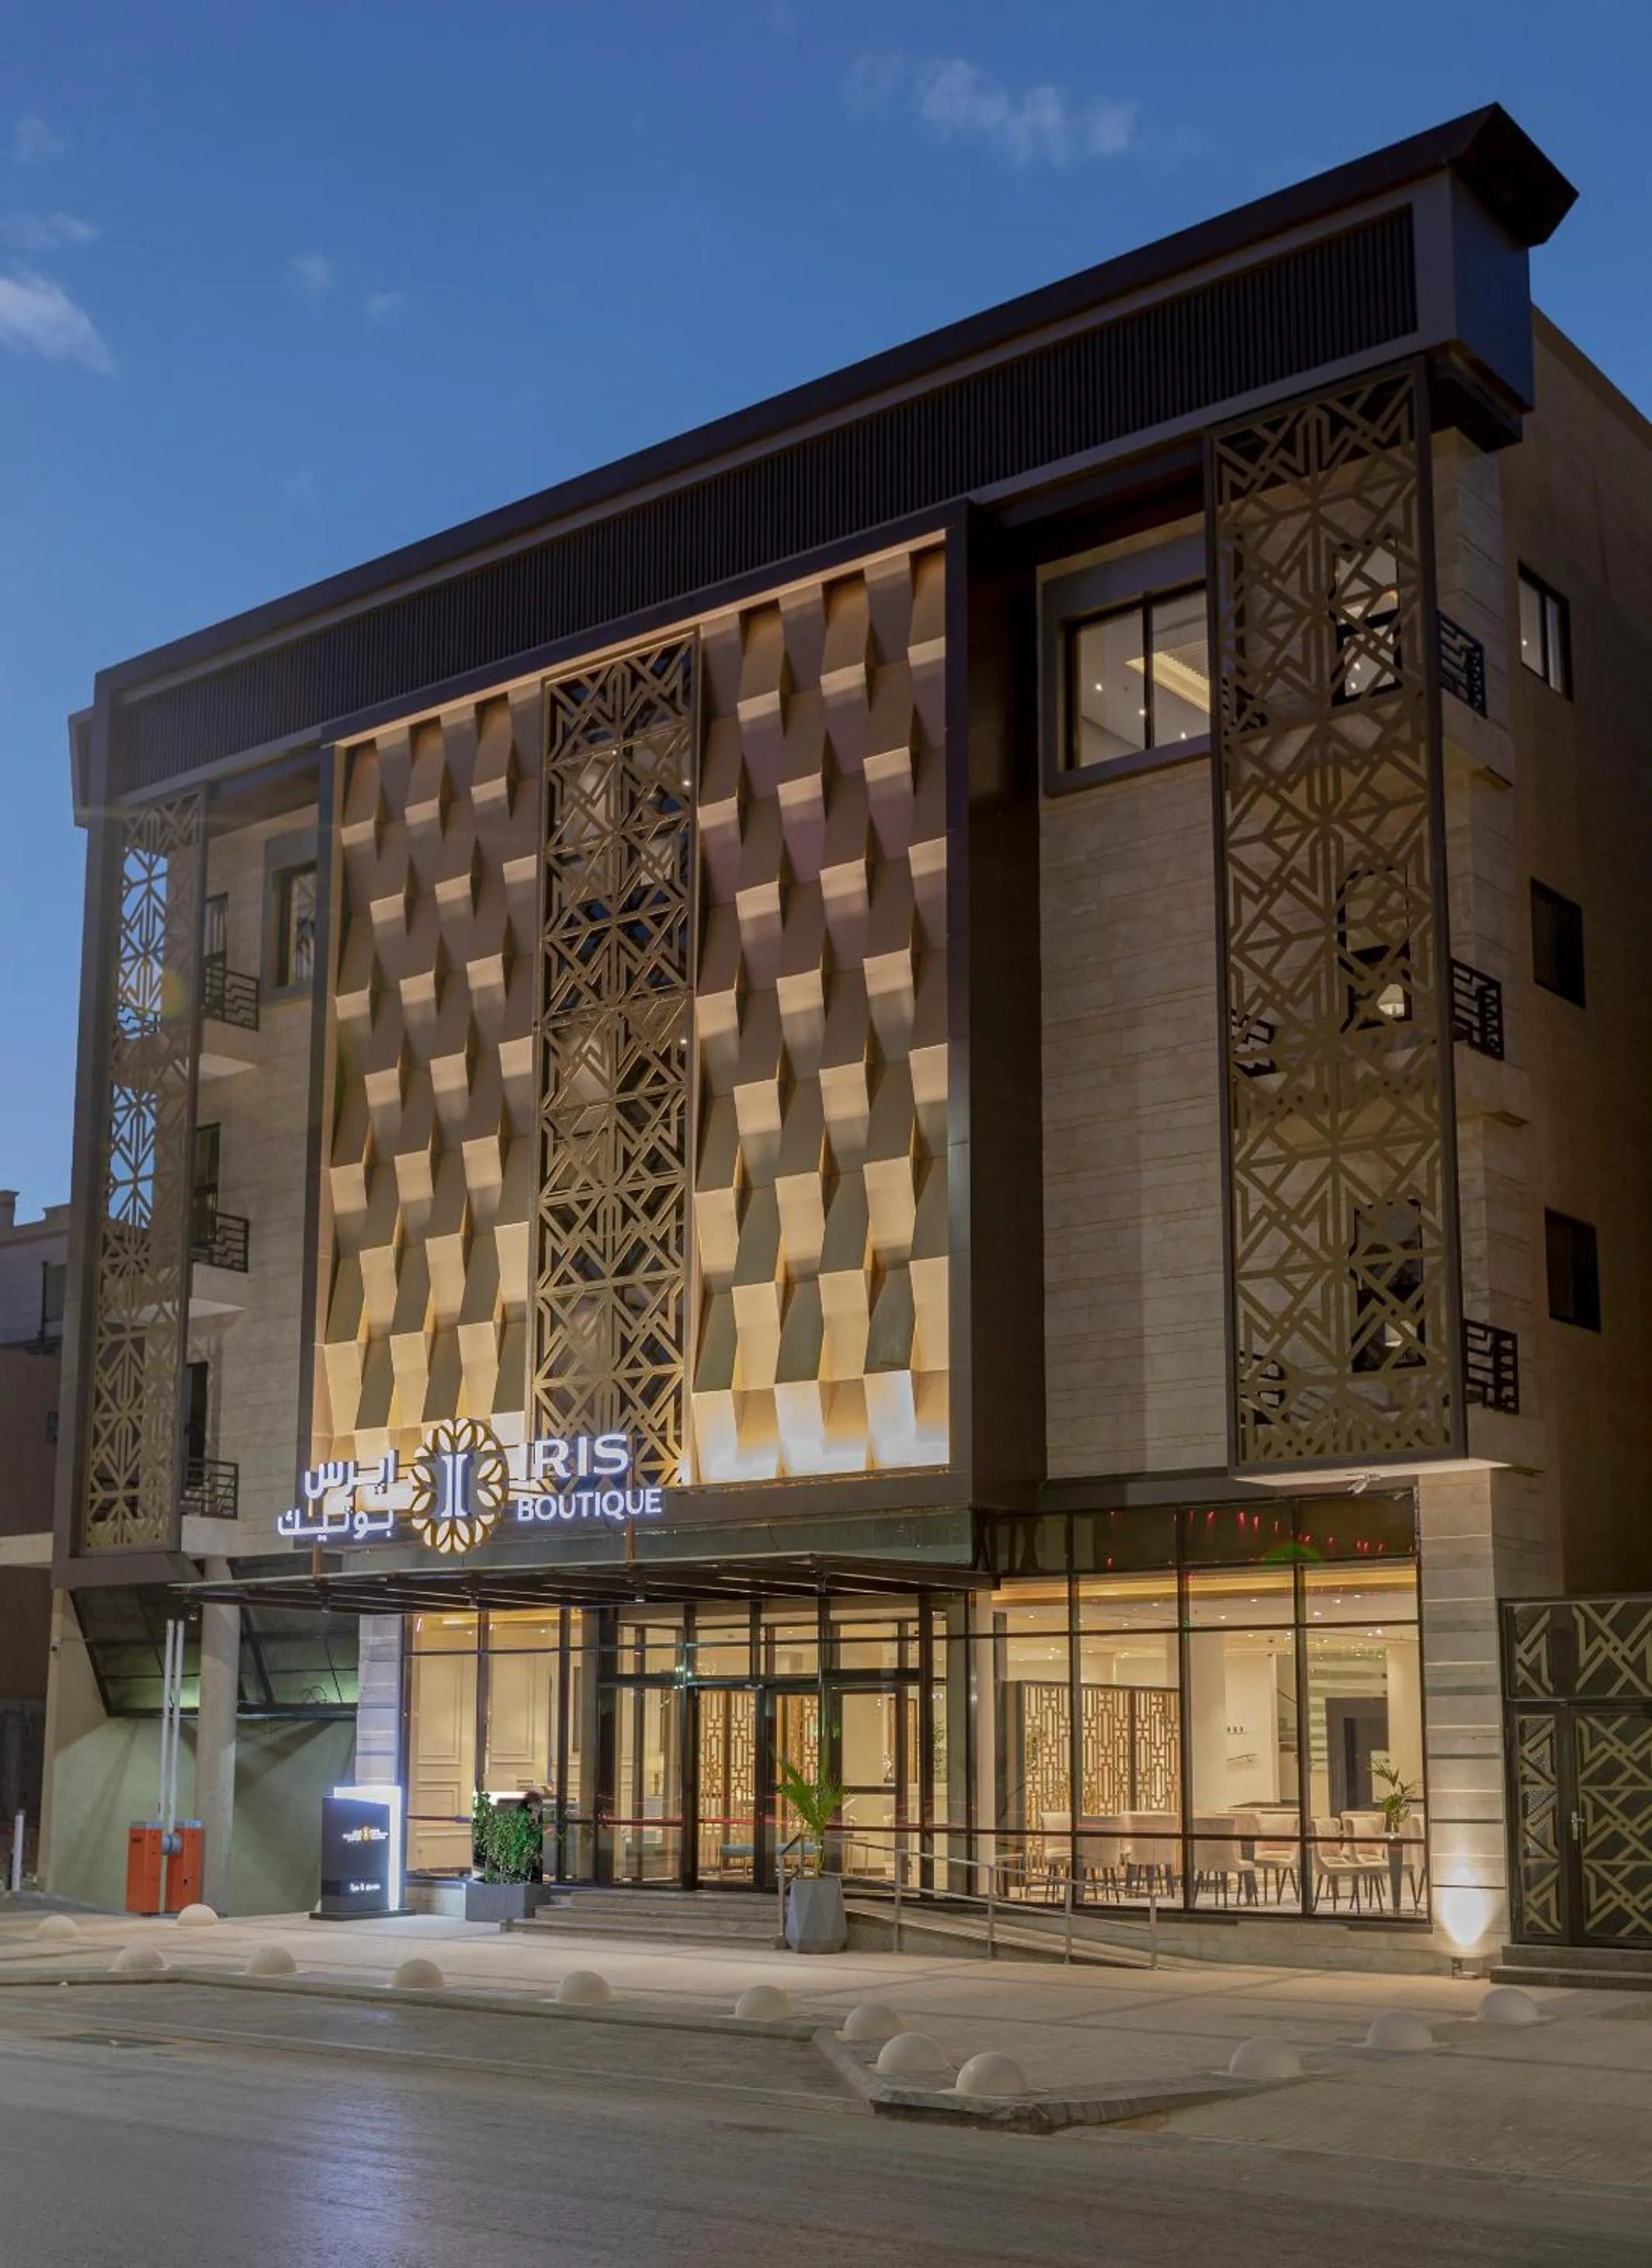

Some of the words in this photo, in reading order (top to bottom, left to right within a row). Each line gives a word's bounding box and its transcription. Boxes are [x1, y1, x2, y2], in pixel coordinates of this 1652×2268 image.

[519, 1433, 629, 1481] IRIS
[516, 1488, 663, 1521] BOUTIQUE
[278, 1506, 394, 1541] بوتيك
